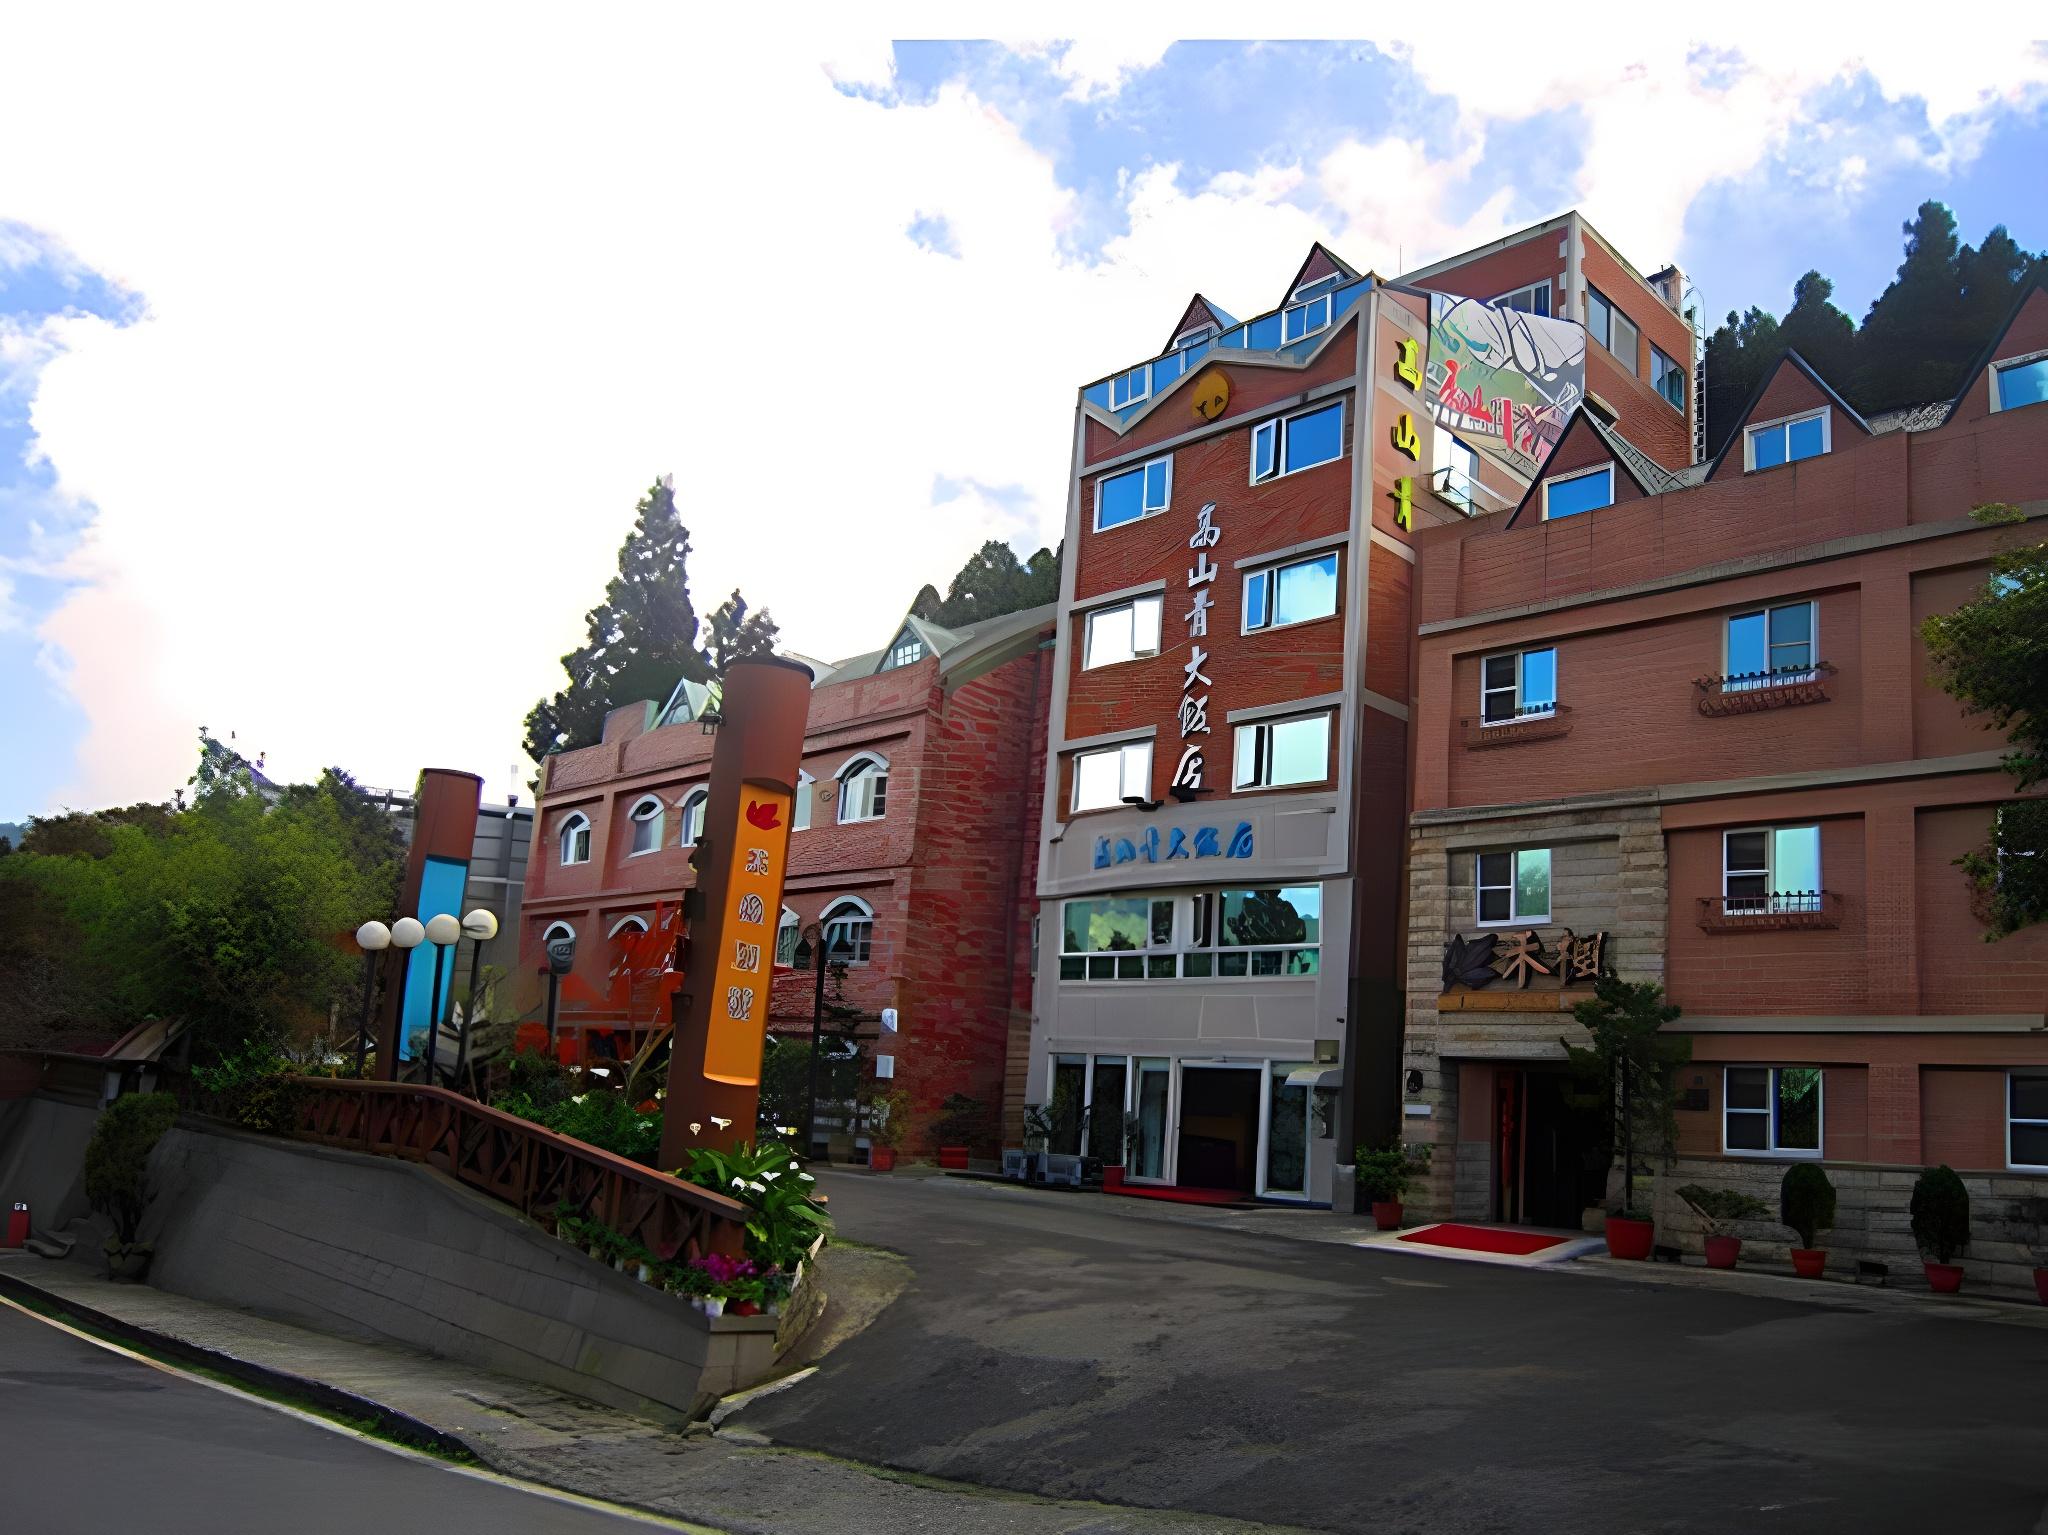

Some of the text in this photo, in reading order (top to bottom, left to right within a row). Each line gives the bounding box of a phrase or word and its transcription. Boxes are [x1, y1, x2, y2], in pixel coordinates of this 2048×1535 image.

[1172, 501, 1220, 788] 高山青大飯店
